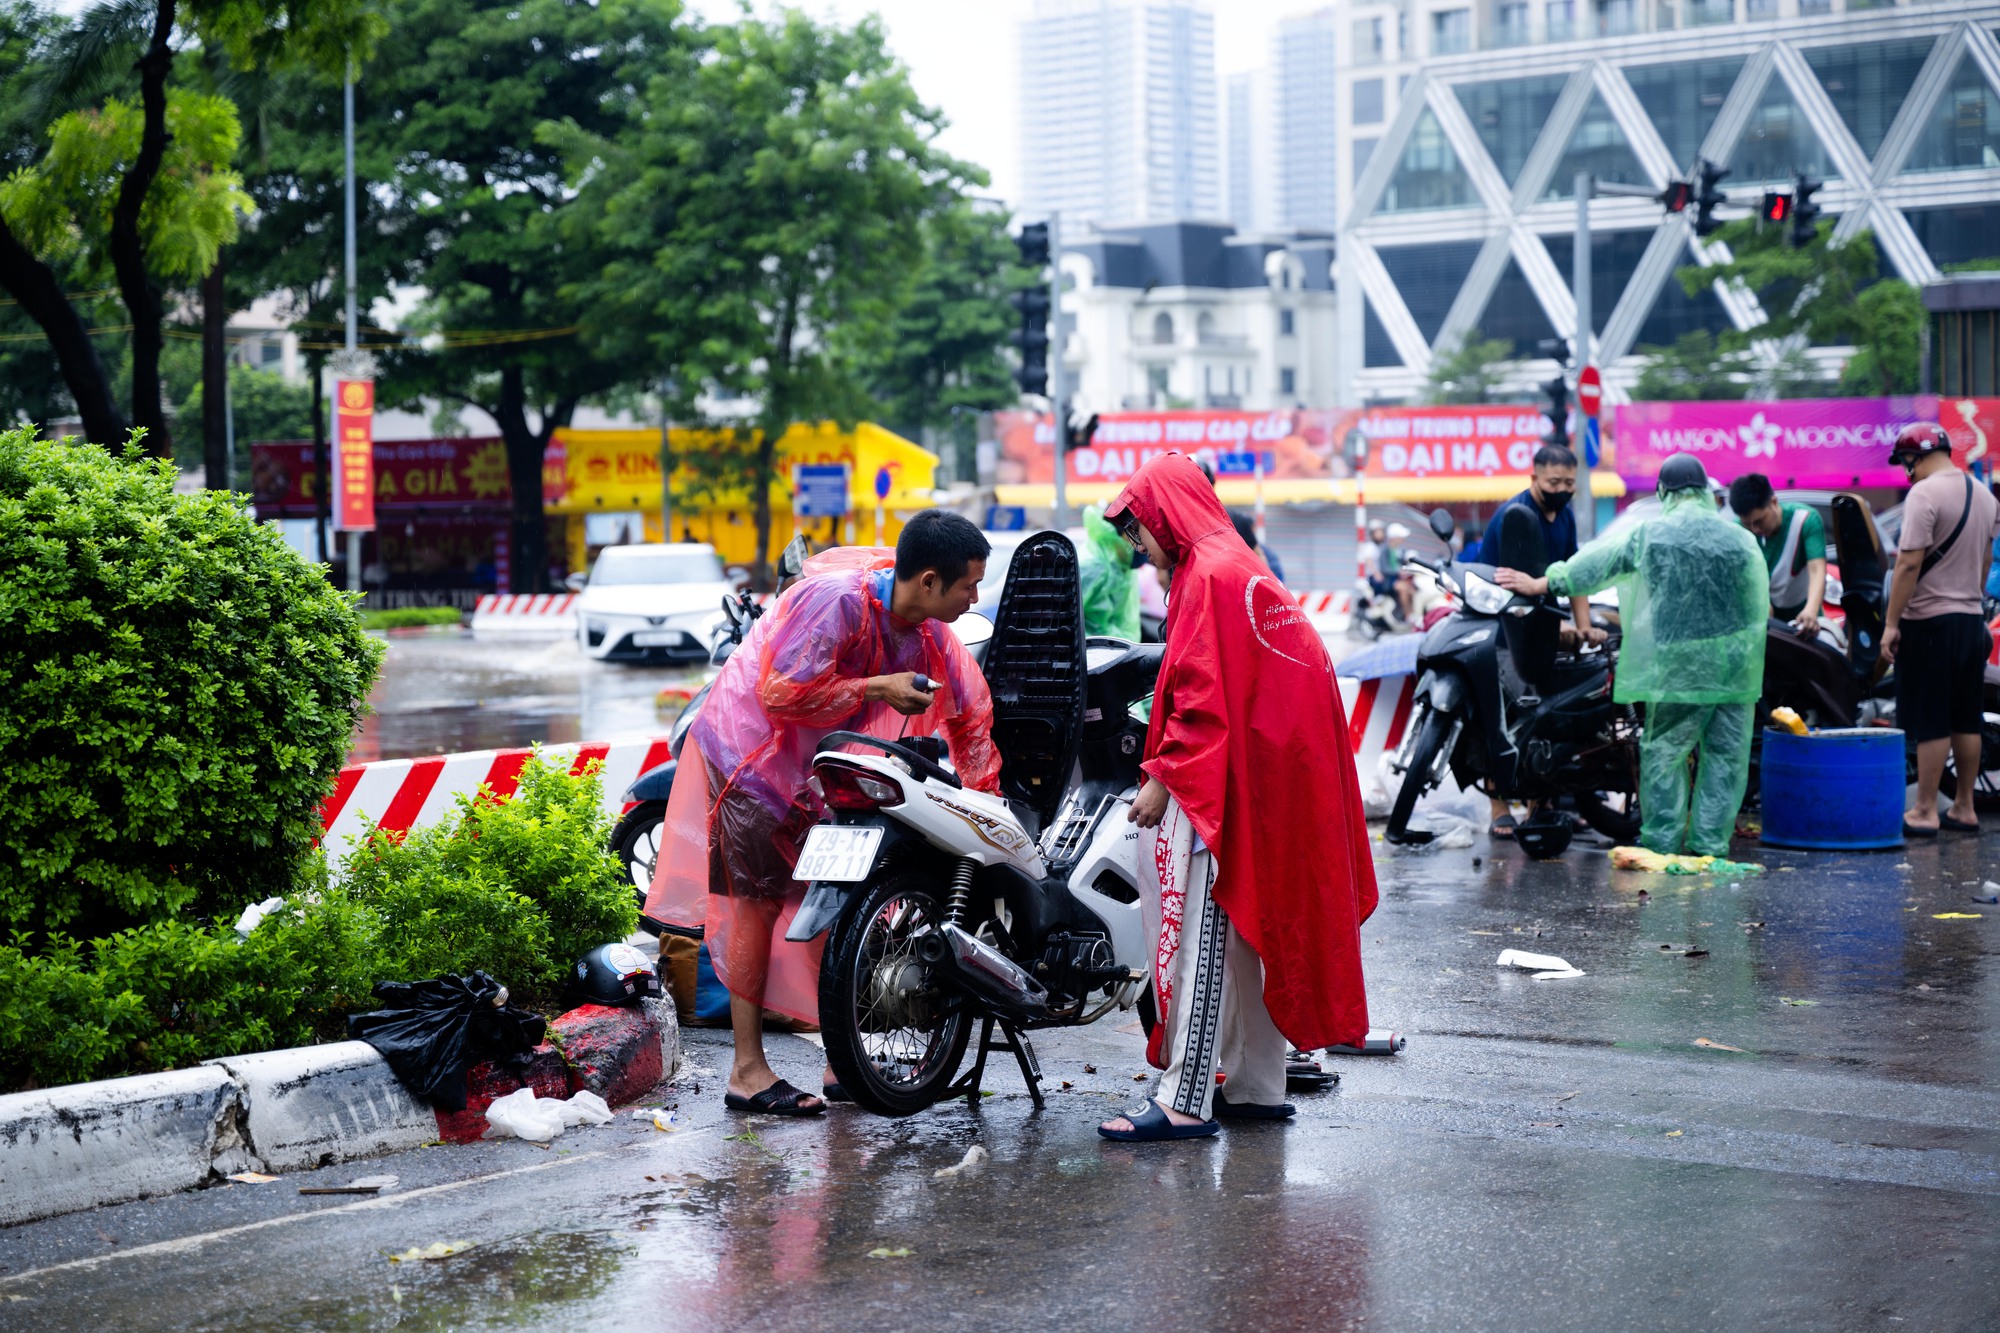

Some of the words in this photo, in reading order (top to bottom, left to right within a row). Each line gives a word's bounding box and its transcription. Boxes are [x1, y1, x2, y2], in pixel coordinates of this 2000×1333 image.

[1649, 427, 1737, 451] MAISON
[1381, 442, 1445, 478] ĐẠI
[1451, 442, 1502, 477] HẠ
[814, 830, 871, 853] 29-X1
[800, 854, 868, 878] 987.11
